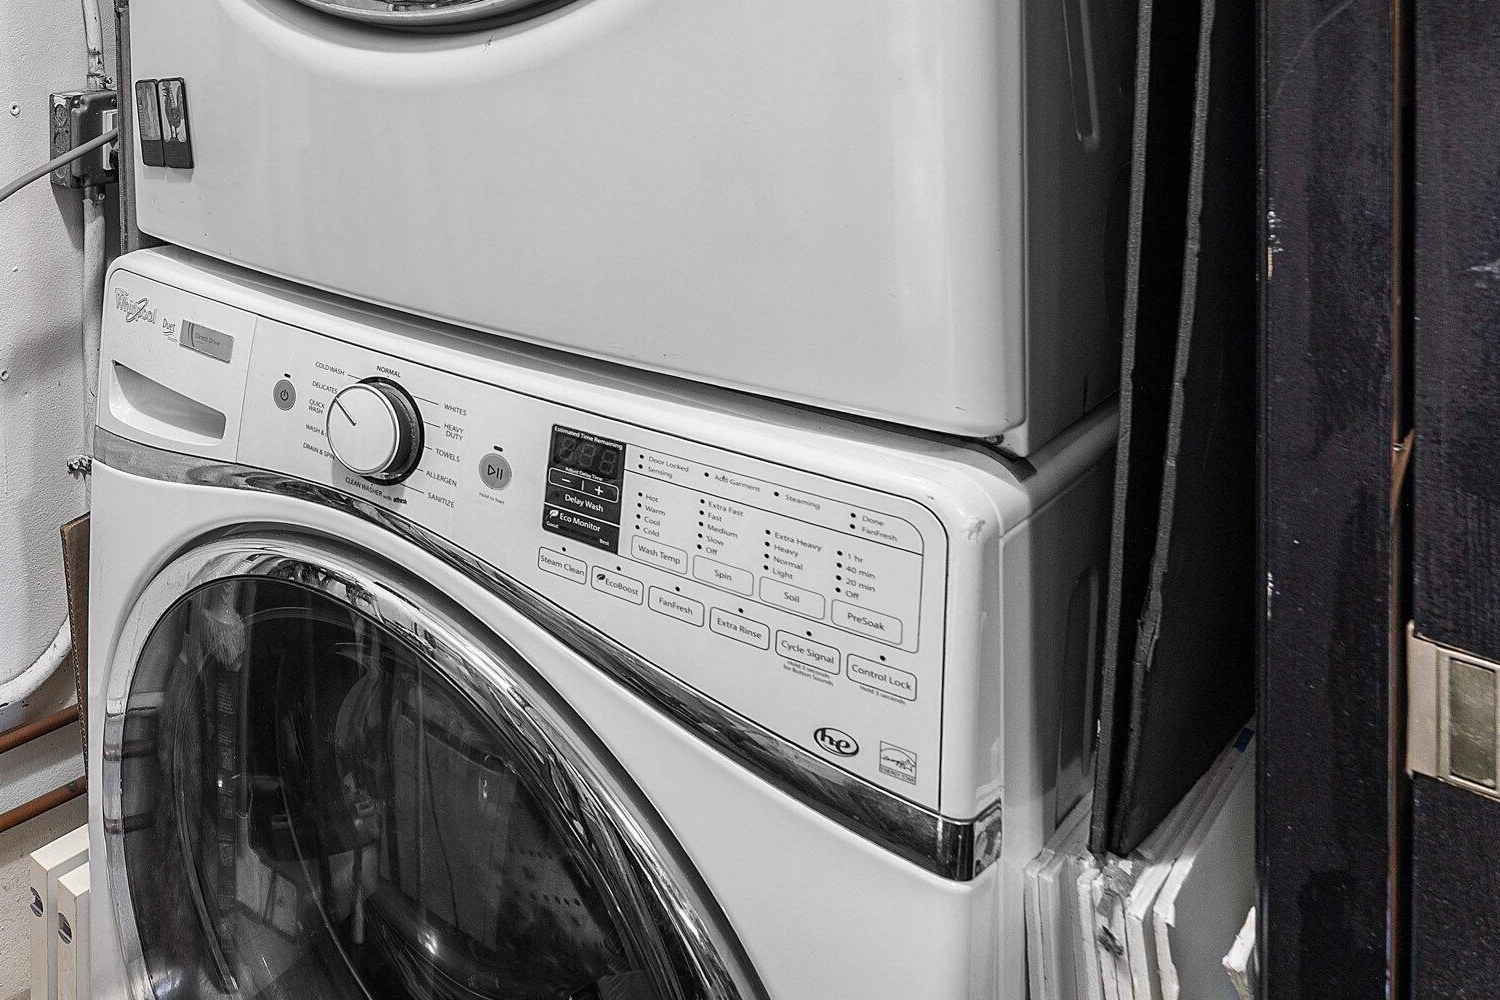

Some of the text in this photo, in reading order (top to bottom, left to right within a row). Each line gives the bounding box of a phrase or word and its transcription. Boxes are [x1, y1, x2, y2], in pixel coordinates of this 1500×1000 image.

[315, 361, 345, 376] COLD WASH
[376, 365, 401, 378] NORMAL
[312, 380, 338, 394] DELICATES
[308, 405, 323, 415] WASH
[309, 398, 325, 409] QUICK
[443, 403, 467, 416] WHITES
[305, 423, 320, 434] WASH
[443, 423, 464, 434] HEAVY
[445, 430, 463, 442] DUTY
[554, 425, 623, 450] Estimated Time Remaining
[302, 442, 318, 454] DRAIN
[323, 451, 335, 461] SPIN
[435, 448, 460, 463] TOWELS
[648, 456, 689, 472] Door Locked
[425, 470, 458, 487] ALLERGEN
[565, 467, 579, 475] Adjust
[579, 470, 591, 479] Delay
[648, 466, 673, 479] Sensing
[345, 476, 361, 489] CLEAN
[361, 482, 383, 498] WASHER
[714, 475, 760, 492] Add Garment
[427, 492, 455, 508] SANITIZE
[565, 493, 604, 513] Delay Wash
[645, 494, 659, 503] Hot
[785, 494, 821, 510] Steaming
[645, 505, 666, 516] Warm
[708, 501, 744, 517] Extra Fast
[559, 512, 601, 532] Eco Monitor
[644, 516, 661, 527] Cool
[708, 512, 722, 522] Fast
[861, 515, 885, 527] Done
[546, 520, 559, 529] Good
[707, 524, 738, 538] Medium
[643, 527, 660, 537] Cold
[861, 526, 898, 542] FanFresh
[706, 535, 724, 546] Slow
[774, 531, 822, 551] Extra Heavy
[638, 544, 681, 565] Wash Temp
[705, 547, 718, 556] Off
[774, 545, 799, 558] Heavy
[540, 554, 585, 577] Steam Clean
[773, 555, 803, 570] Normal
[854, 555, 864, 564] hr
[714, 569, 732, 581] Spin
[772, 567, 793, 580] Light
[845, 566, 876, 579] 40 min
[605, 577, 639, 597] EcoBoost
[845, 578, 876, 592] 20 min
[784, 591, 800, 603] Soil
[845, 590, 859, 600] Off
[658, 597, 693, 615] FanFresh
[847, 612, 885, 631] PreSoak
[716, 617, 763, 640] Extra Rinse
[781, 639, 834, 665] Cycle Signal
[806, 666, 830, 679] seconds
[851, 664, 912, 691] Control Lock
[812, 673, 834, 686] Sounds
[880, 693, 906, 705] seconds
